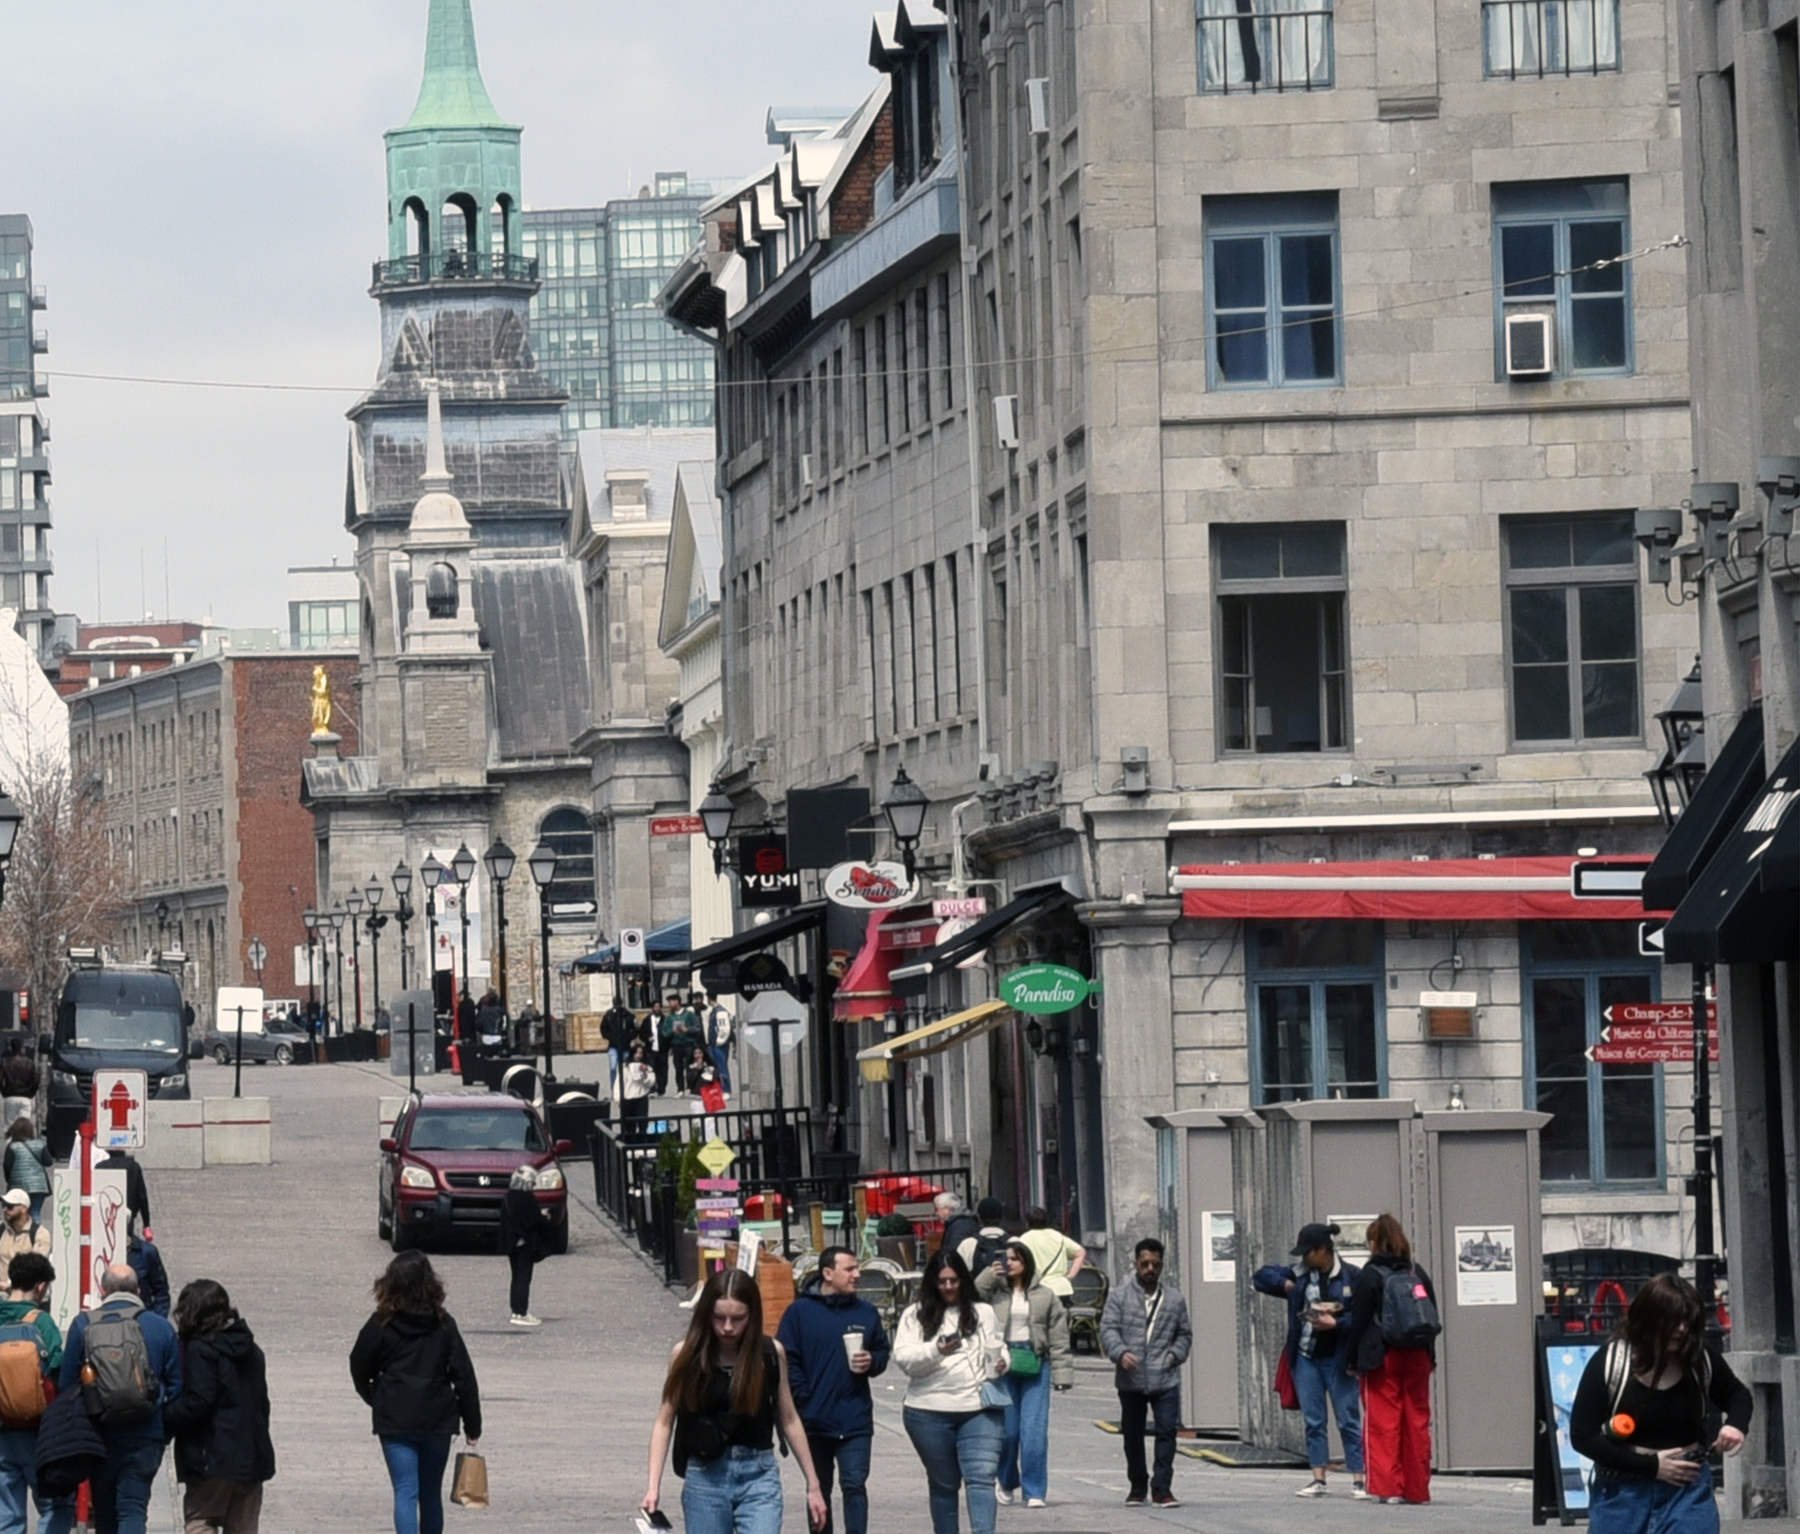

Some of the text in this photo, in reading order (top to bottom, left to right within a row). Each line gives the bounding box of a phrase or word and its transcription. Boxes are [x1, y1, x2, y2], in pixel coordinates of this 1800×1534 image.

[744, 873, 798, 889] YUMI
[940, 901, 980, 914] DULCE
[1013, 979, 1075, 1003] Paradiso
[1613, 1026, 1642, 1039] Musée
[1644, 1027, 1656, 1039] du
